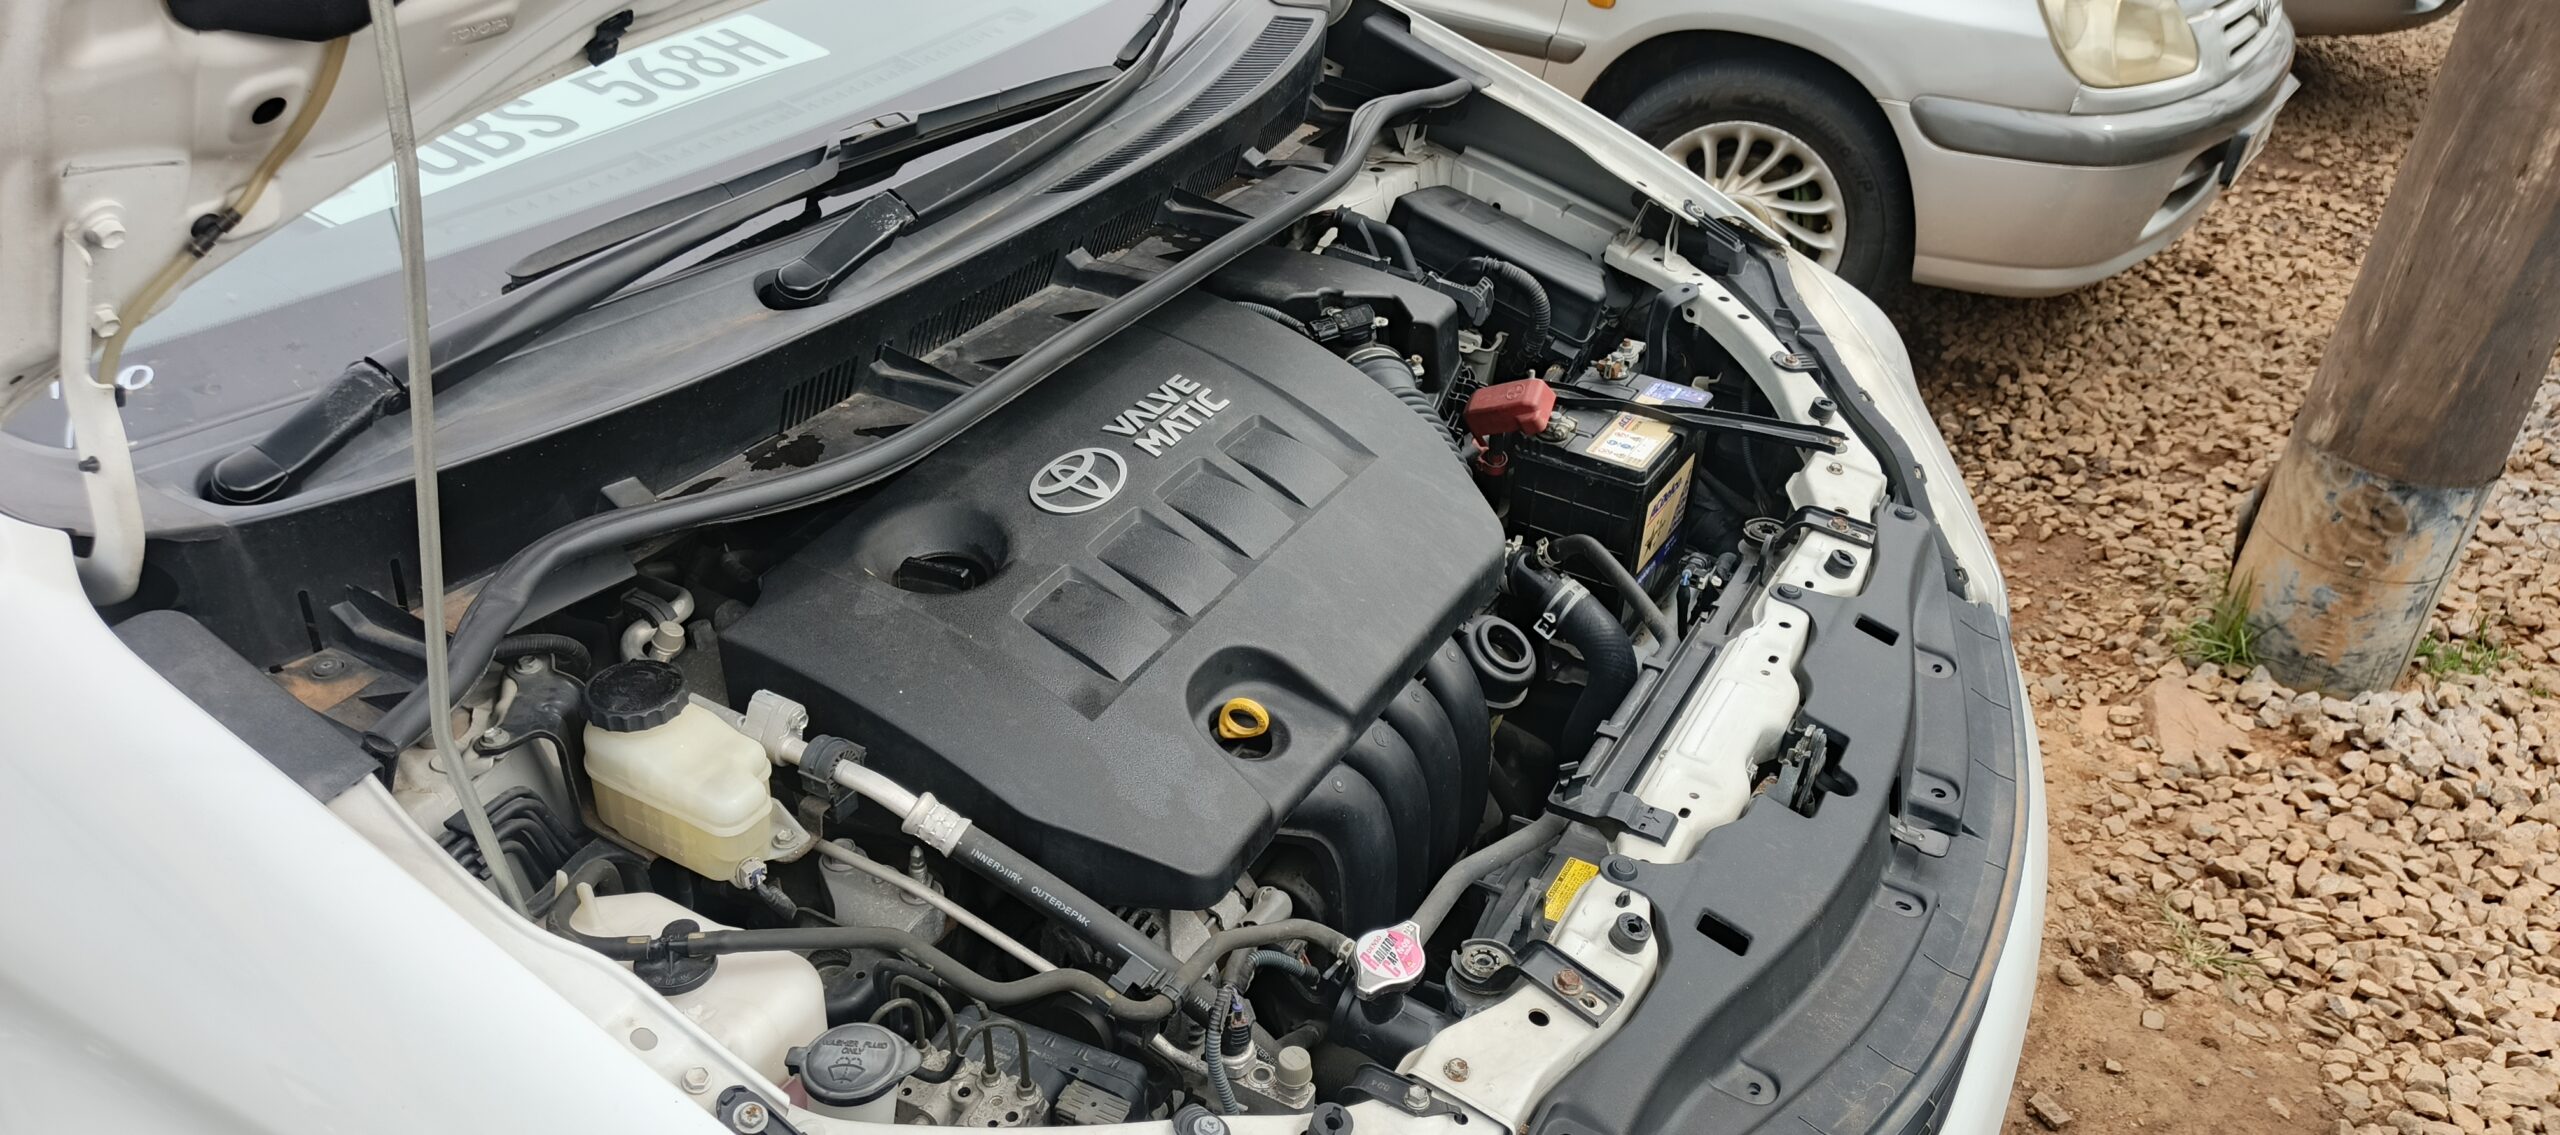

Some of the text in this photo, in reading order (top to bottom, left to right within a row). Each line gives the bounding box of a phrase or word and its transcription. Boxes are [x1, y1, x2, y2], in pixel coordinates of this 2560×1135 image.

[418, 28, 790, 175] UBS 568H
[1101, 373, 1201, 435] VALVE
[1133, 387, 1231, 458] MATIC
[1366, 935, 1382, 954] DENSO
[1381, 951, 1401, 977] CAP
[822, 1039, 888, 1049] WASHER FLUID
[841, 1047, 865, 1055] ONLY
